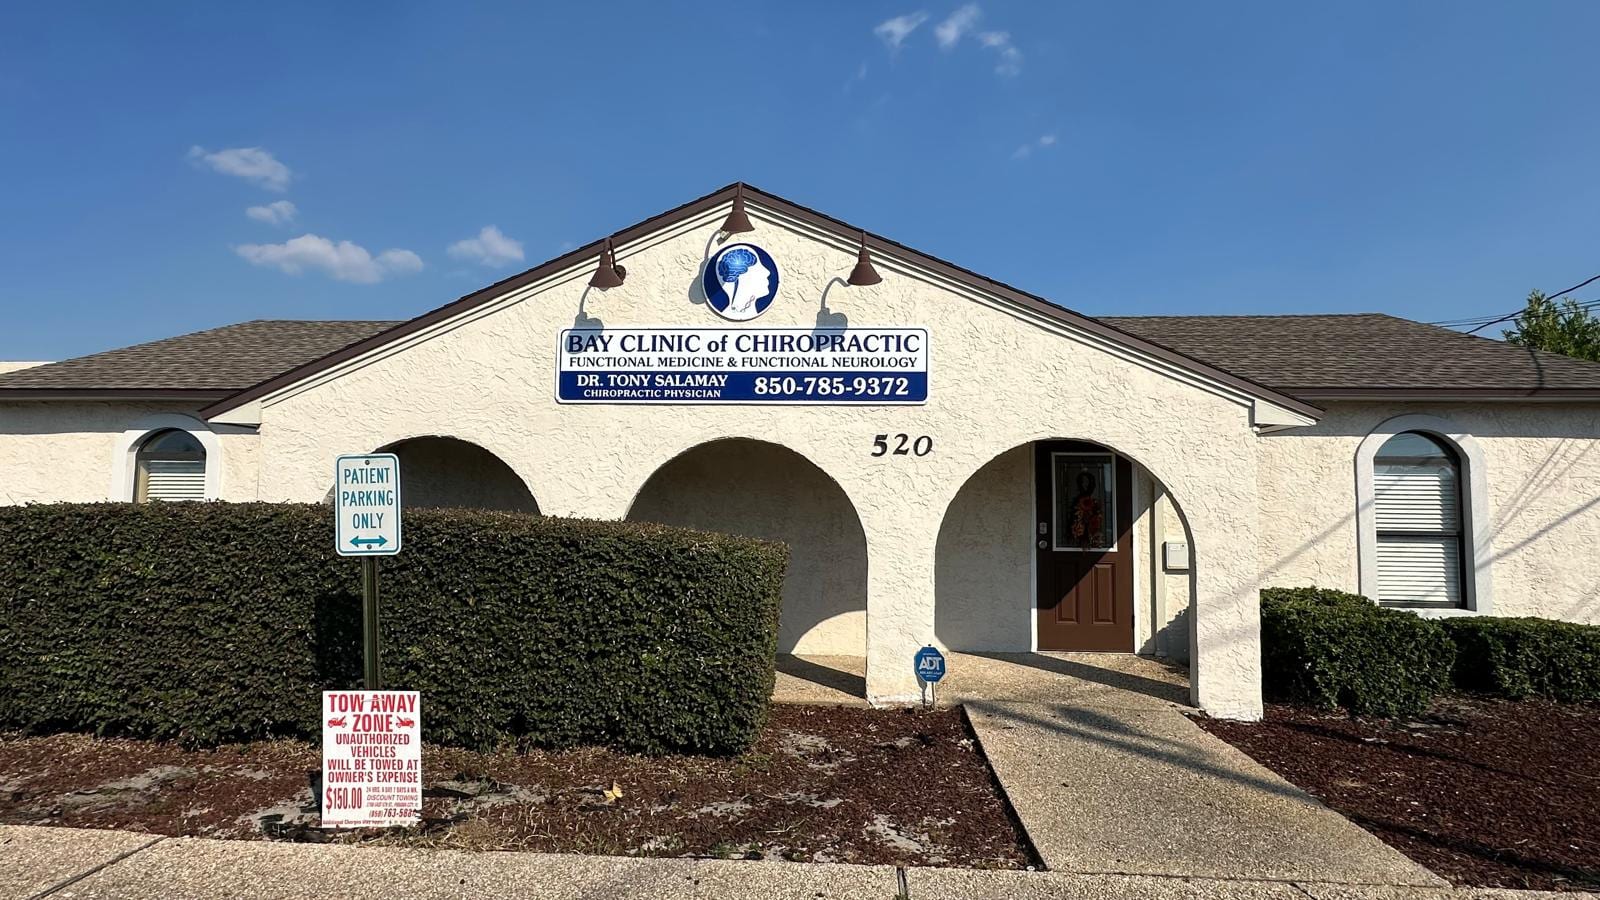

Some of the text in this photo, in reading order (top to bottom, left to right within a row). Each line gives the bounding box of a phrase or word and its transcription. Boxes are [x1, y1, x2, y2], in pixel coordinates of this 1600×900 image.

[568, 334, 920, 353] BAY CLINIC of CHIROPRACTIC
[569, 356, 918, 368] FUNCTIONAL MEDICINE & FUNCTIONAL NEUROLOGY
[576, 374, 728, 387] DR. TONY SALAMAY
[754, 377, 909, 396] 850-785-9372
[583, 389, 721, 399] CHIROPRACTIC PHYSICIAN
[871, 433, 933, 458] 520
[344, 467, 390, 484] PATIENT
[342, 490, 393, 507] PARKING
[353, 513, 384, 529] ONLY
[918, 656, 942, 671] ADT
[328, 694, 417, 712] TOW AWAY
[352, 714, 393, 732] ZONE
[336, 733, 410, 745] UNAUTHORIZED
[351, 746, 396, 757] VEHICLES
[327, 759, 419, 770] WILL BE TOWED AT
[328, 771, 418, 783] OWNER'S EXPENSE
[326, 785, 363, 815] $150.00
